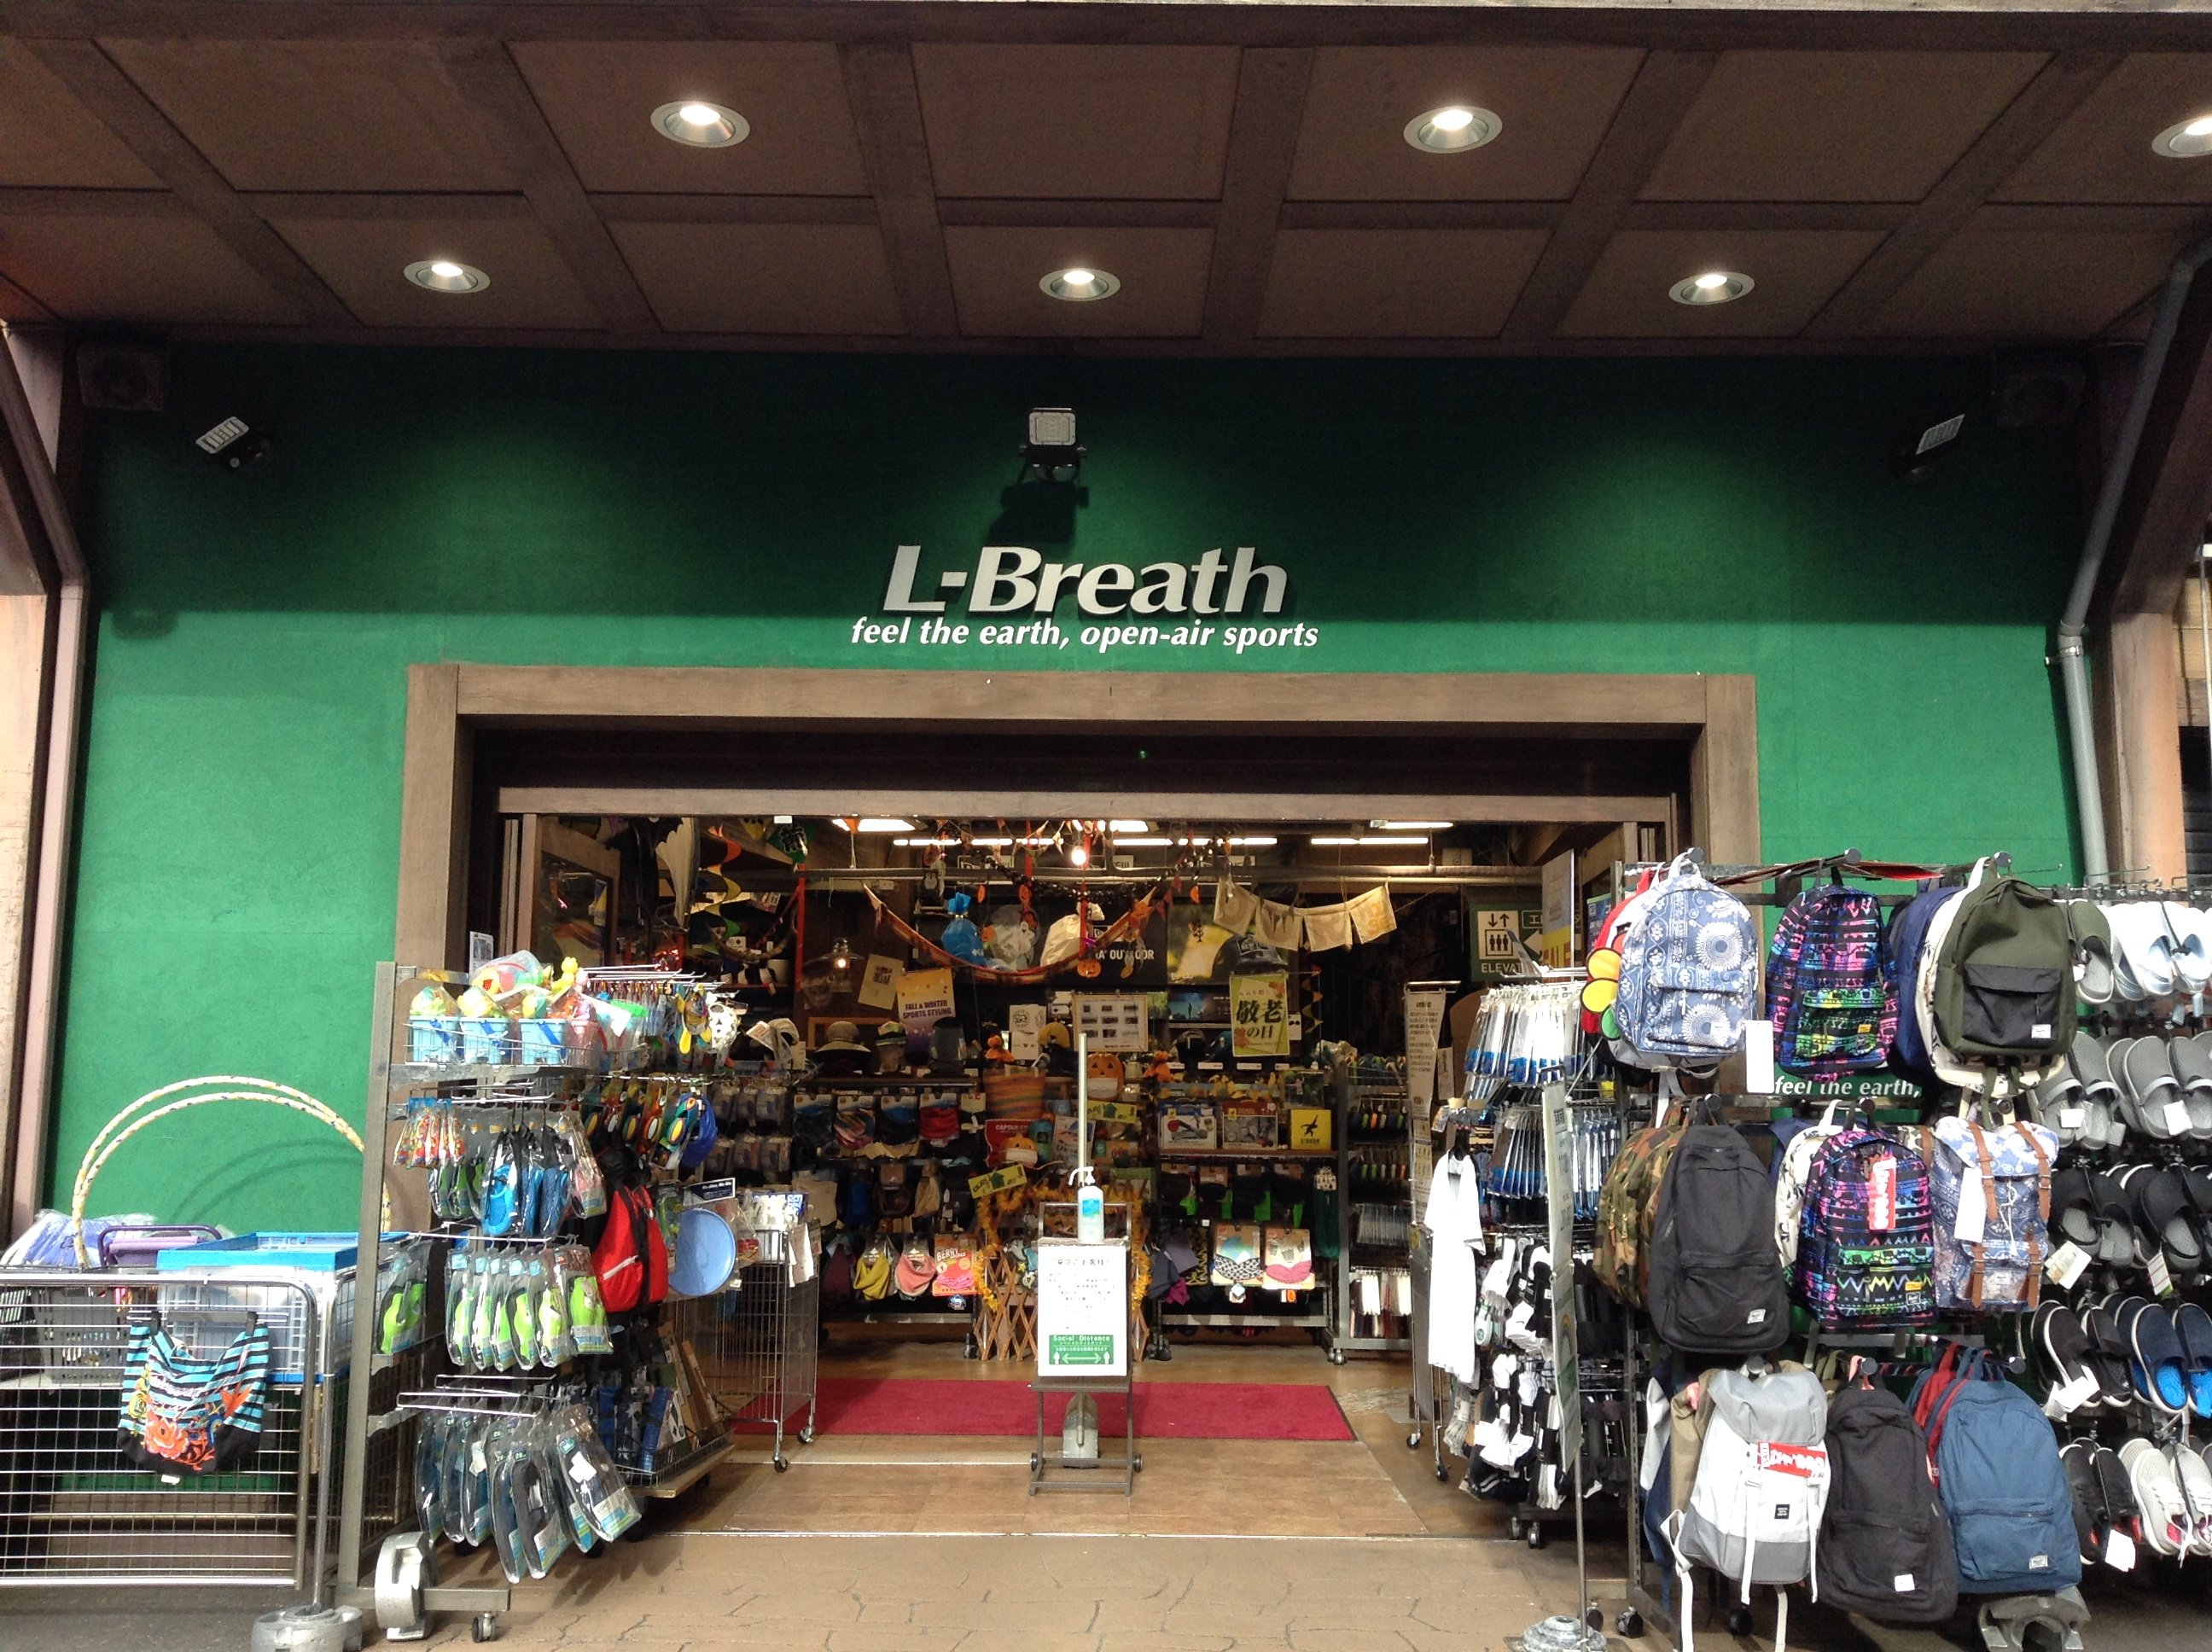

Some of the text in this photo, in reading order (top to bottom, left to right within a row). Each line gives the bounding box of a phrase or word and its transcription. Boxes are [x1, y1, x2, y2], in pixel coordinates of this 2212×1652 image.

[882, 544, 1289, 614] L-Breath
[852, 616, 1318, 654] feel the earth, open-air sports
[1774, 1075, 1812, 1095] feel
[1859, 1079, 1921, 1098] earth,
